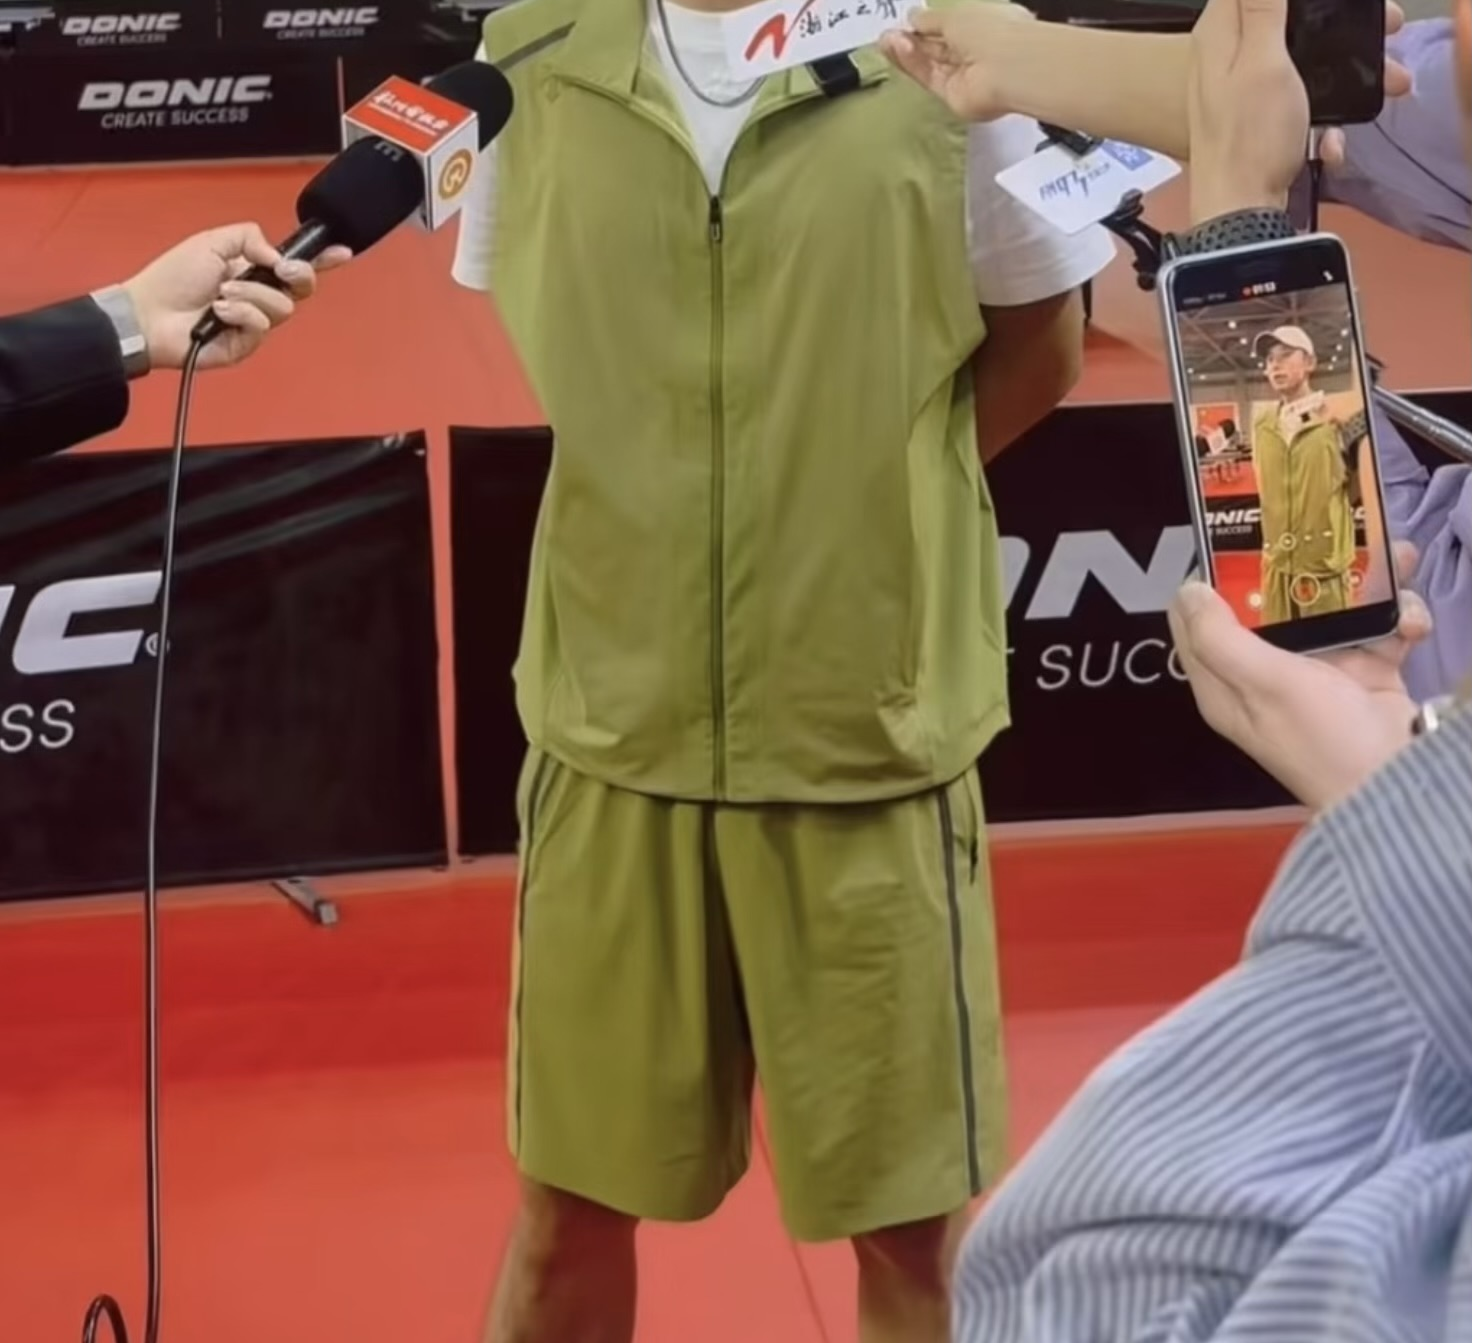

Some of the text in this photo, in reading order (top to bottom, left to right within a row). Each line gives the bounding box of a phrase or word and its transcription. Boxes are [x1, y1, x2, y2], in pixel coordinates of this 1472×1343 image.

[62, 12, 182, 36] DONIC
[261, 6, 380, 29] DONIC
[77, 74, 272, 111] DONIC
[101, 106, 249, 130] CREATE SUCCESS
